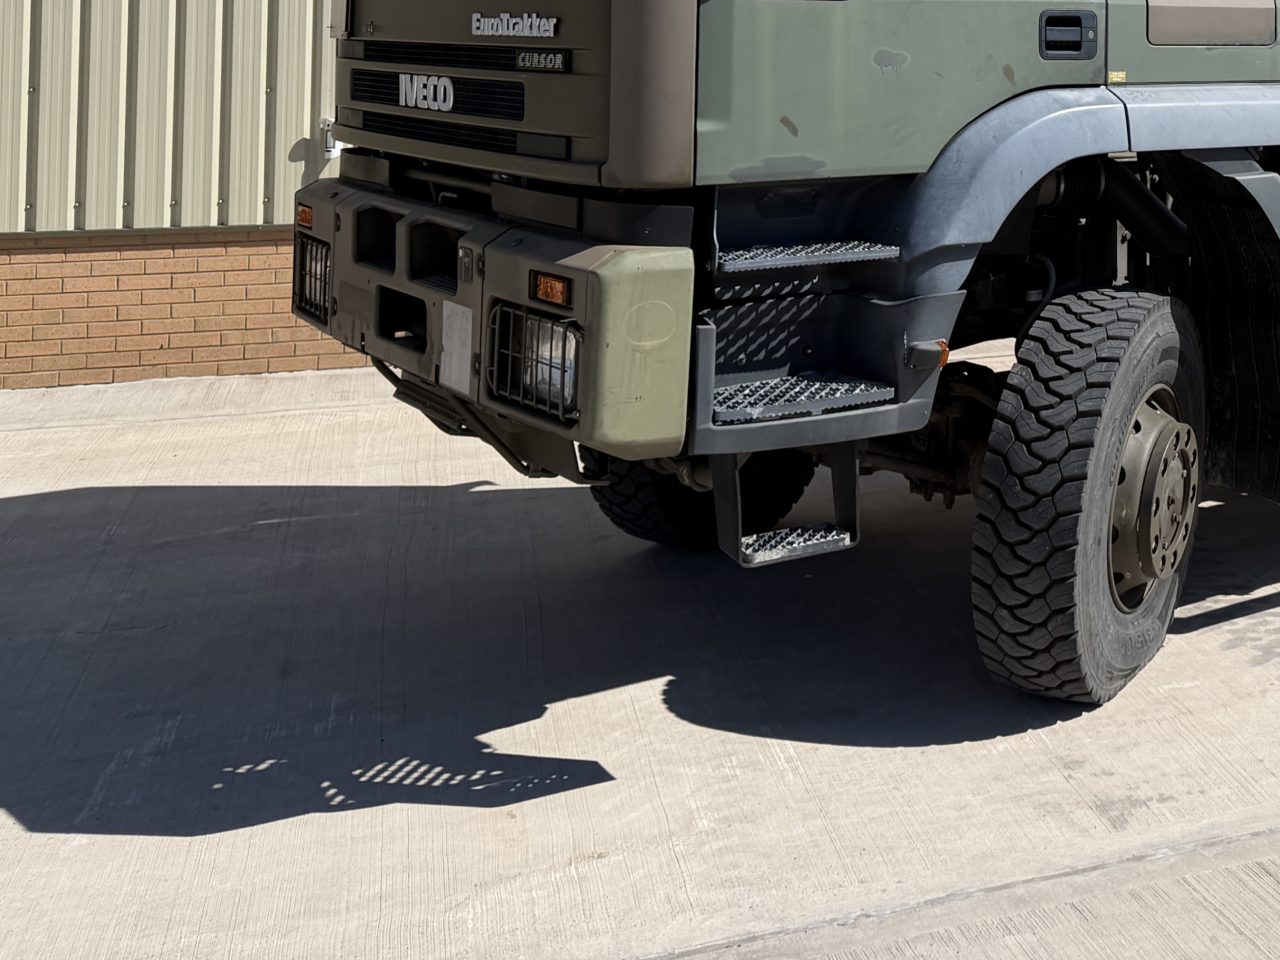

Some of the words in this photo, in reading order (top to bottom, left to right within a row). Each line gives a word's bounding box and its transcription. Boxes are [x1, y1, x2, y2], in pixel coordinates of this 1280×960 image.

[471, 12, 558, 37] EuroTrakker
[517, 52, 564, 70] CURSOR
[398, 73, 454, 112] IVECO
